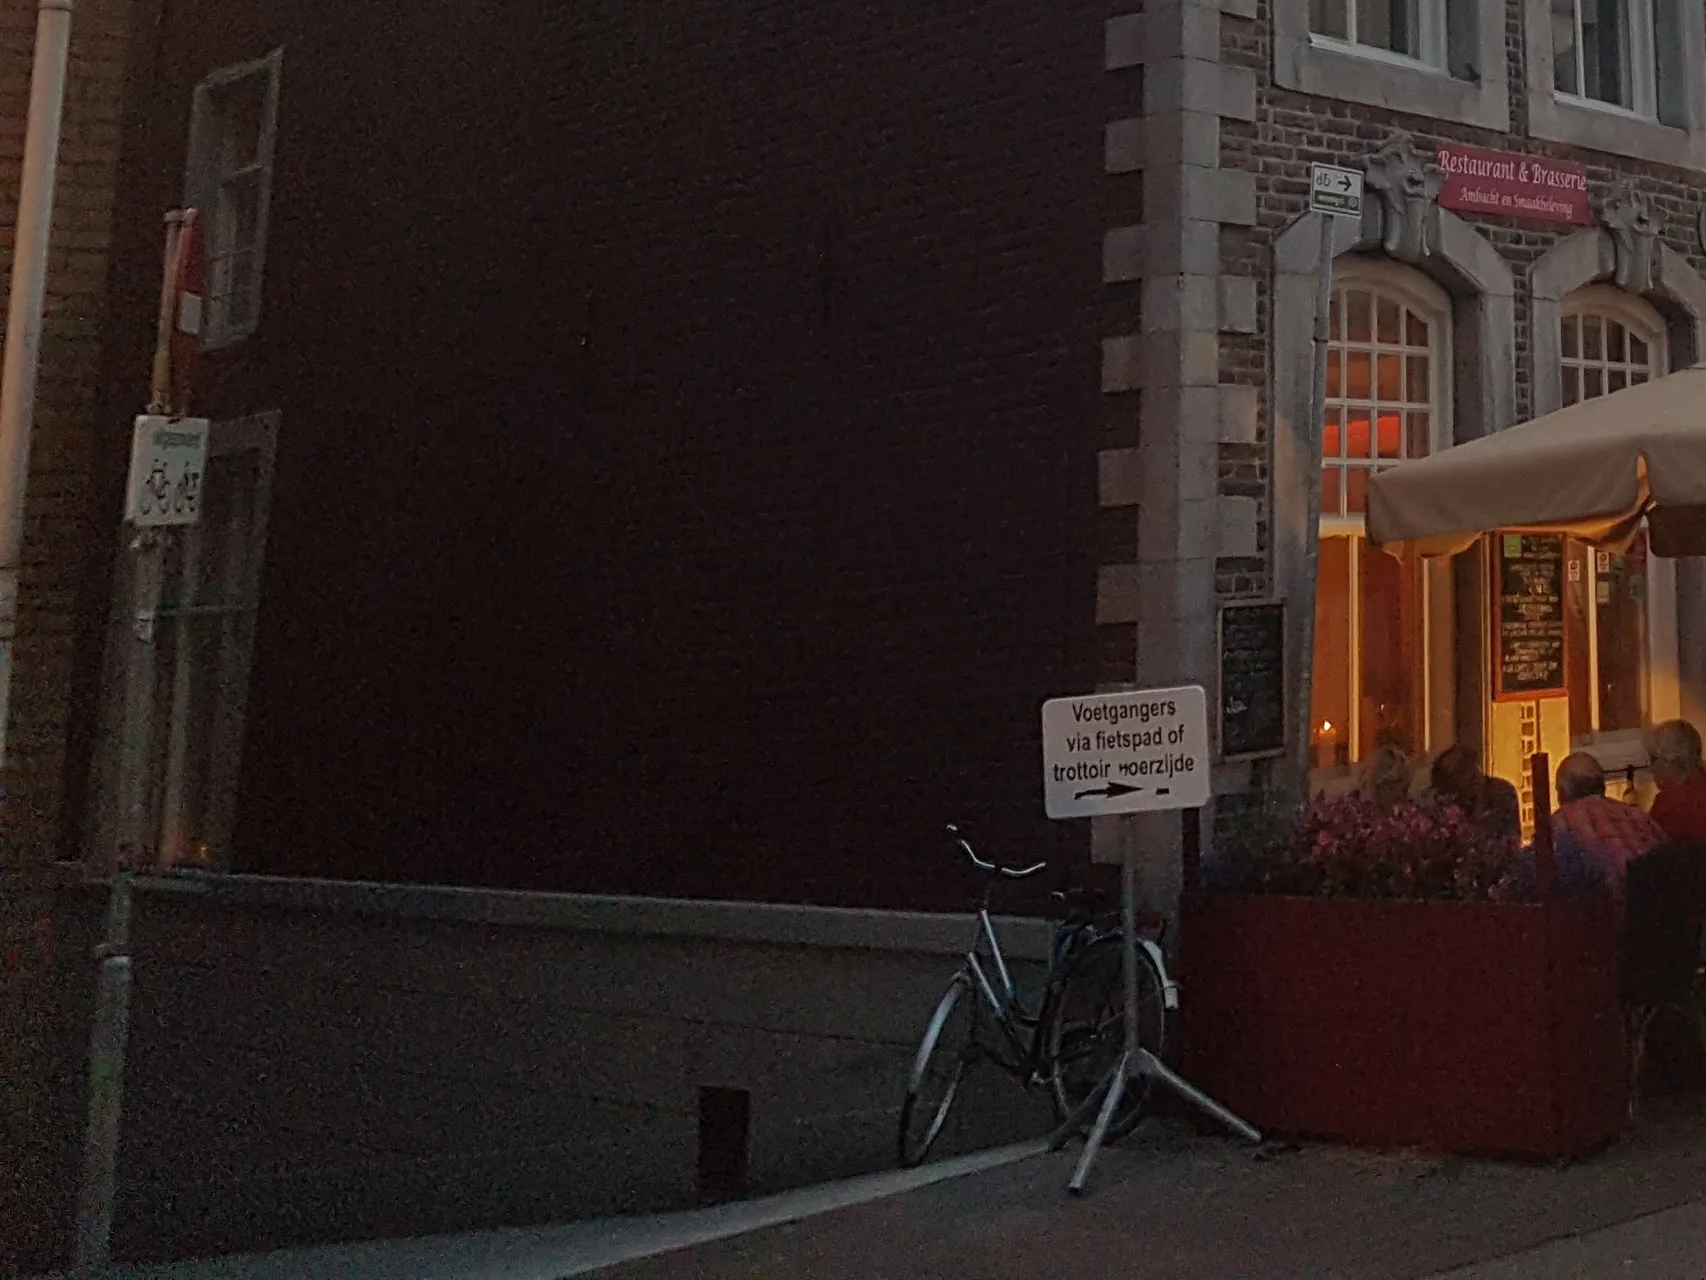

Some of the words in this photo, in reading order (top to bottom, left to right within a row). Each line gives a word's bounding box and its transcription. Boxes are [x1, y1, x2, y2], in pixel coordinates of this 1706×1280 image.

[1438, 150, 1515, 180] Restaurant
[1519, 161, 1529, 183] &
[1531, 164, 1588, 191] Brasserie
[1071, 700, 1176, 725] Voetgangers
[1066, 732, 1092, 753] via
[1096, 726, 1163, 752] fietspad
[1168, 724, 1185, 745] of
[1053, 758, 1111, 782] trottoir
